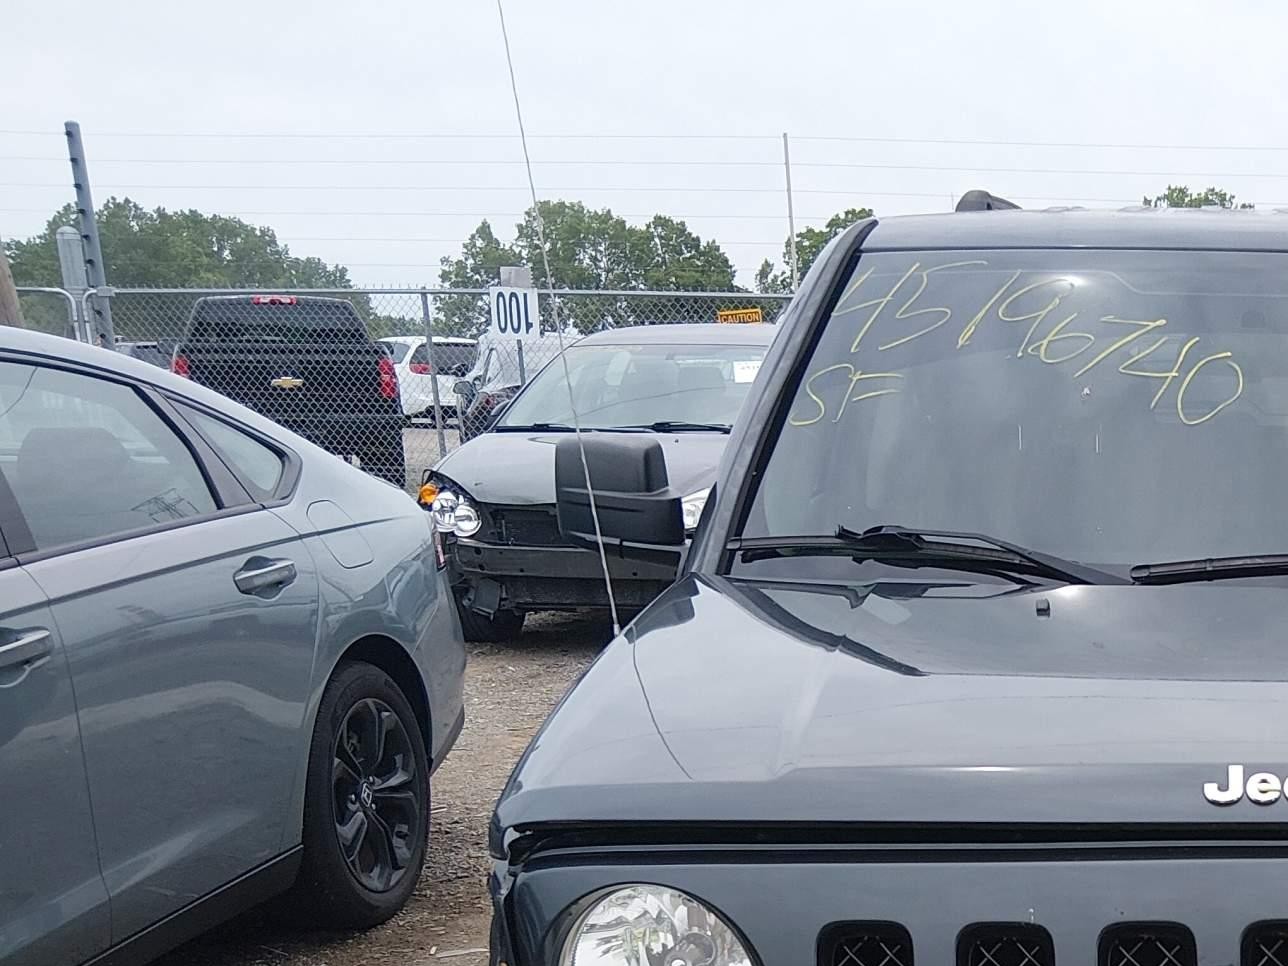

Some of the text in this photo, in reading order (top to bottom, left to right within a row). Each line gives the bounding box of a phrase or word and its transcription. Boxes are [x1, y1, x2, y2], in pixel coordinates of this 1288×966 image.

[721, 312, 759, 323] CAUTION
[831, 260, 1244, 426] 45196740
[789, 363, 903, 427] SF
